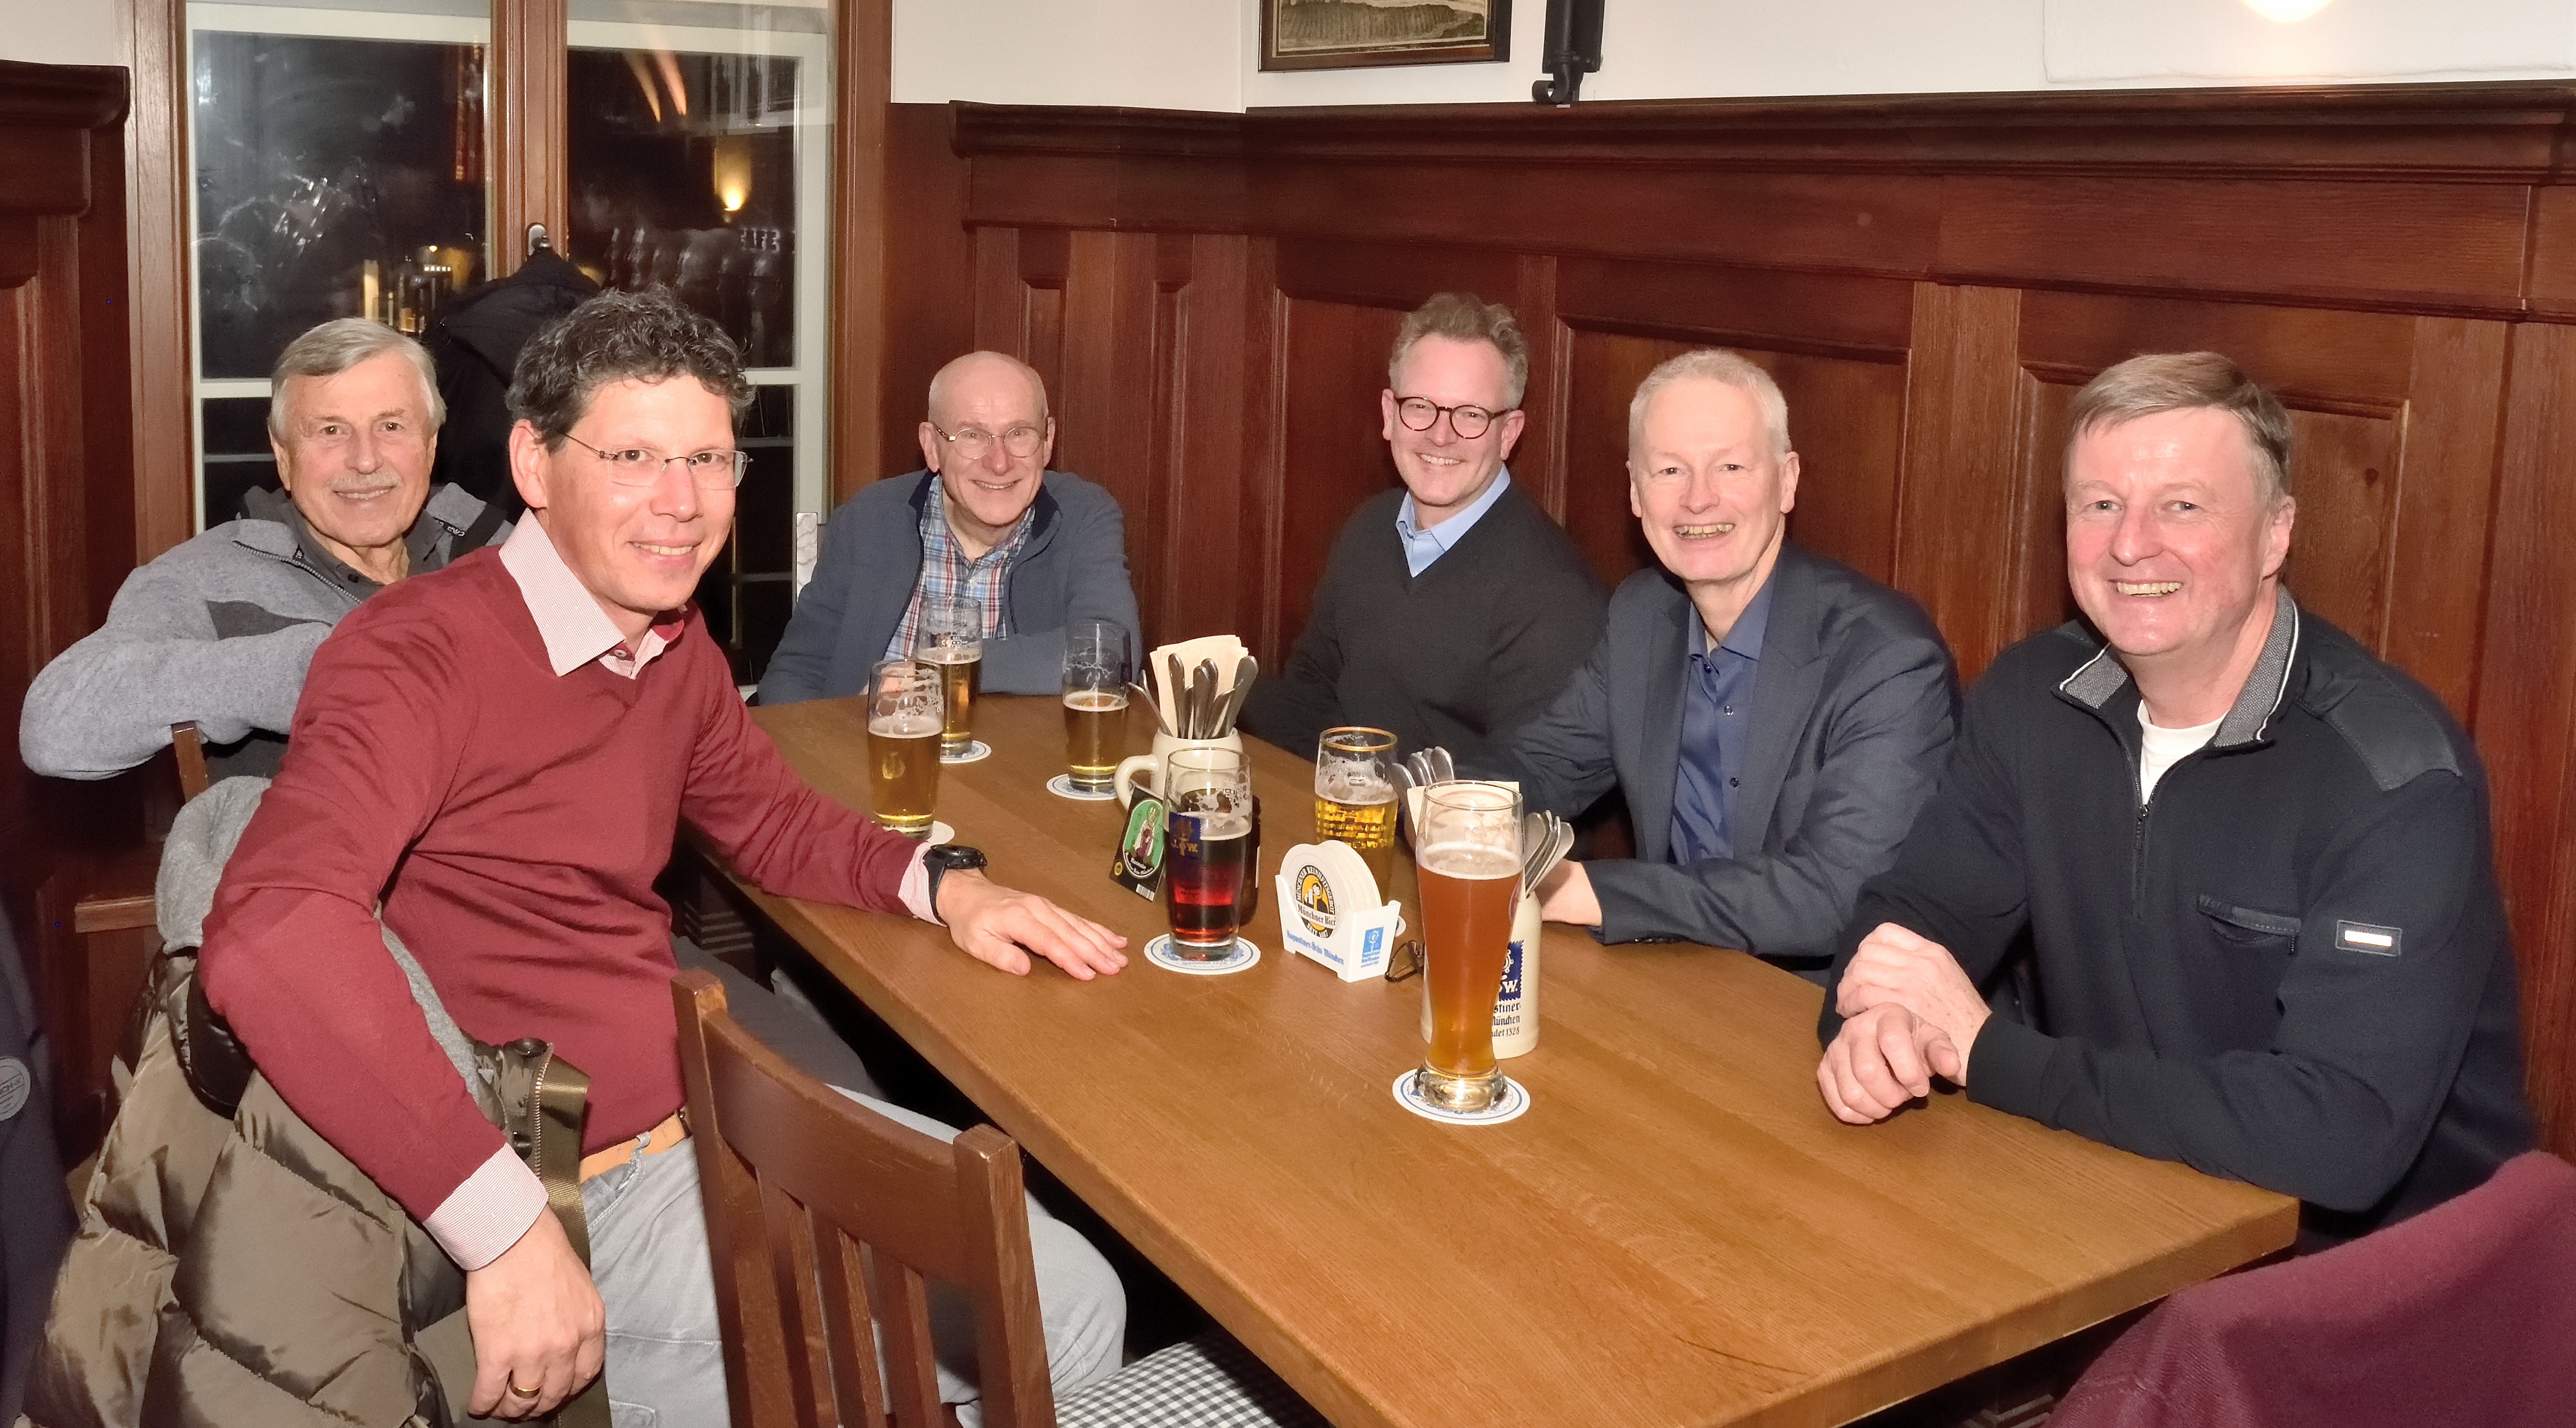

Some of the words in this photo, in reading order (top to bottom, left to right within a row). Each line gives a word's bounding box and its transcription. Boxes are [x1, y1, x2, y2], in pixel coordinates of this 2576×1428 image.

[1296, 868, 1307, 902] MÜNCHNER
[1307, 866, 1335, 914] REINHEITSGEBOT
[1298, 903, 1324, 924] Münchner
[1325, 915, 1336, 926] Bier
[1307, 923, 1318, 936] SEIT
[1506, 1027, 1520, 1036] 1328
